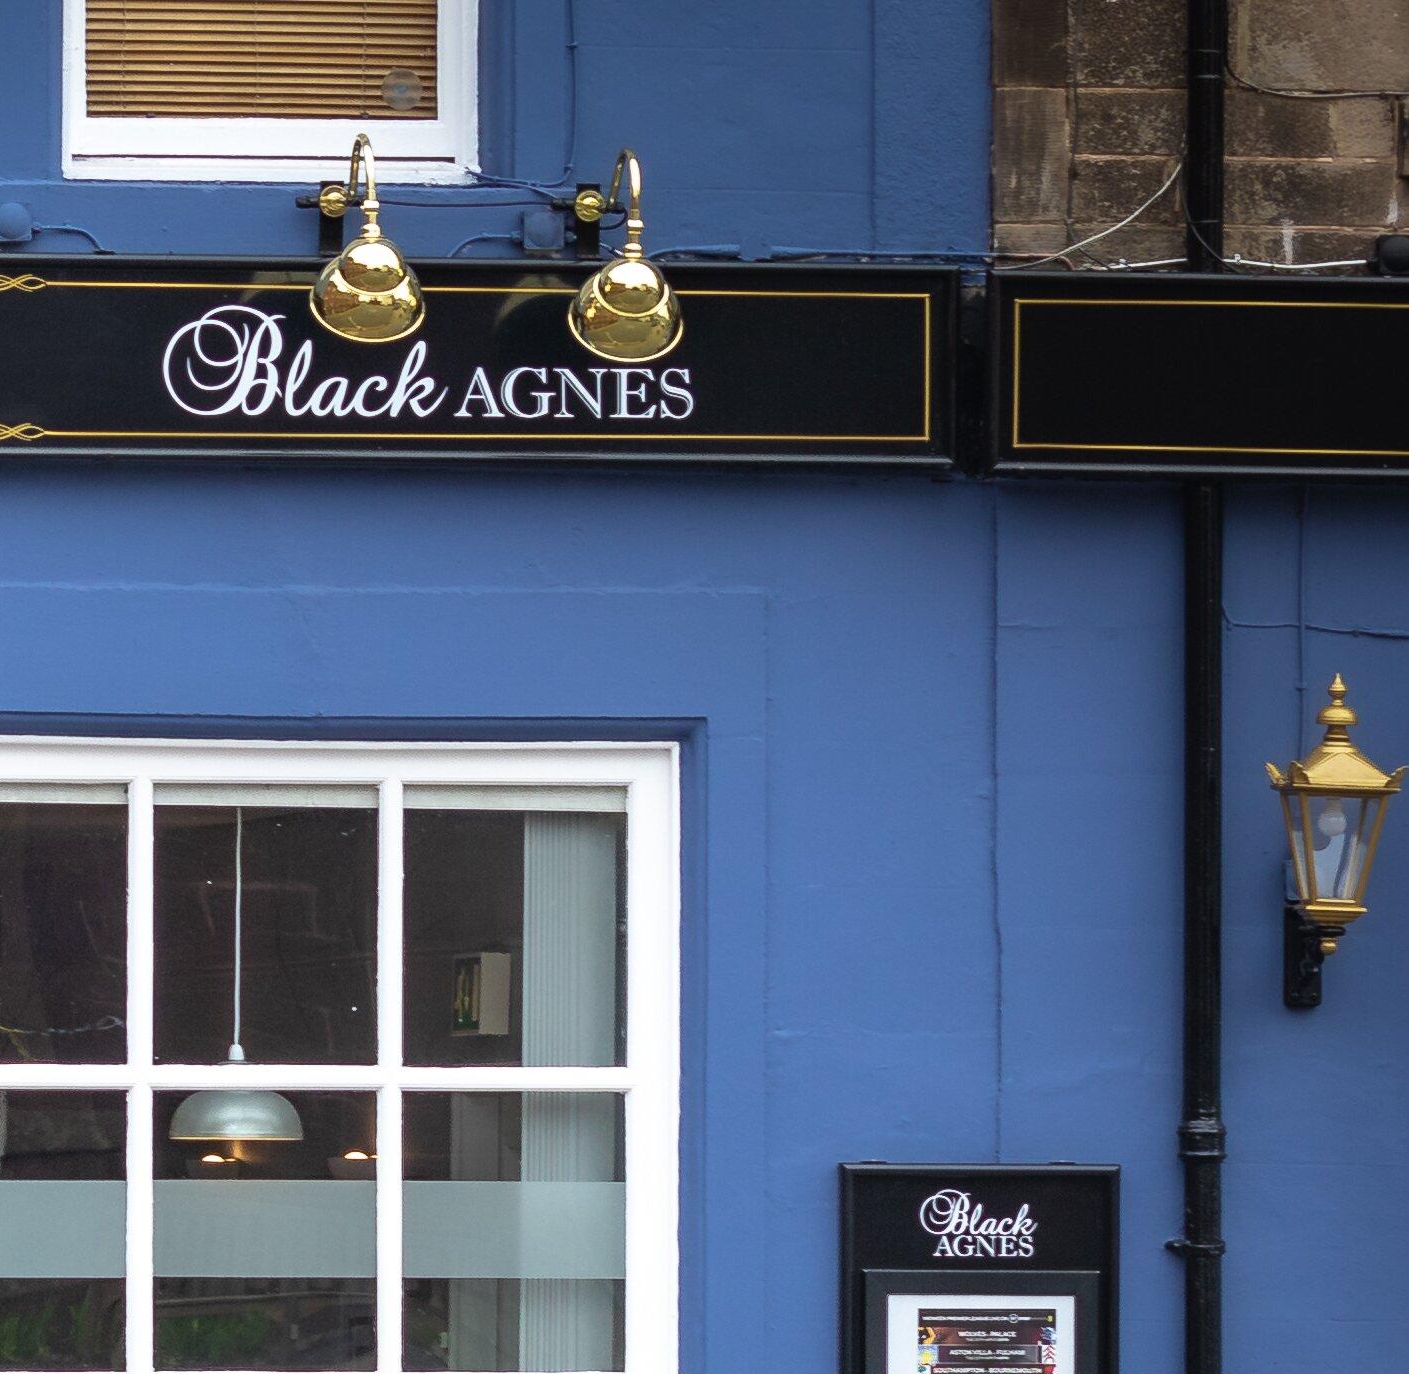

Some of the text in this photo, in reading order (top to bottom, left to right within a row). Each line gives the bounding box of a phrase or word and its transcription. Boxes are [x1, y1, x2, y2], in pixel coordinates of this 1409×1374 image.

[162, 304, 694, 420] Black AGNES
[919, 1189, 1038, 1236] Black
[932, 1234, 1034, 1258] AGNES
